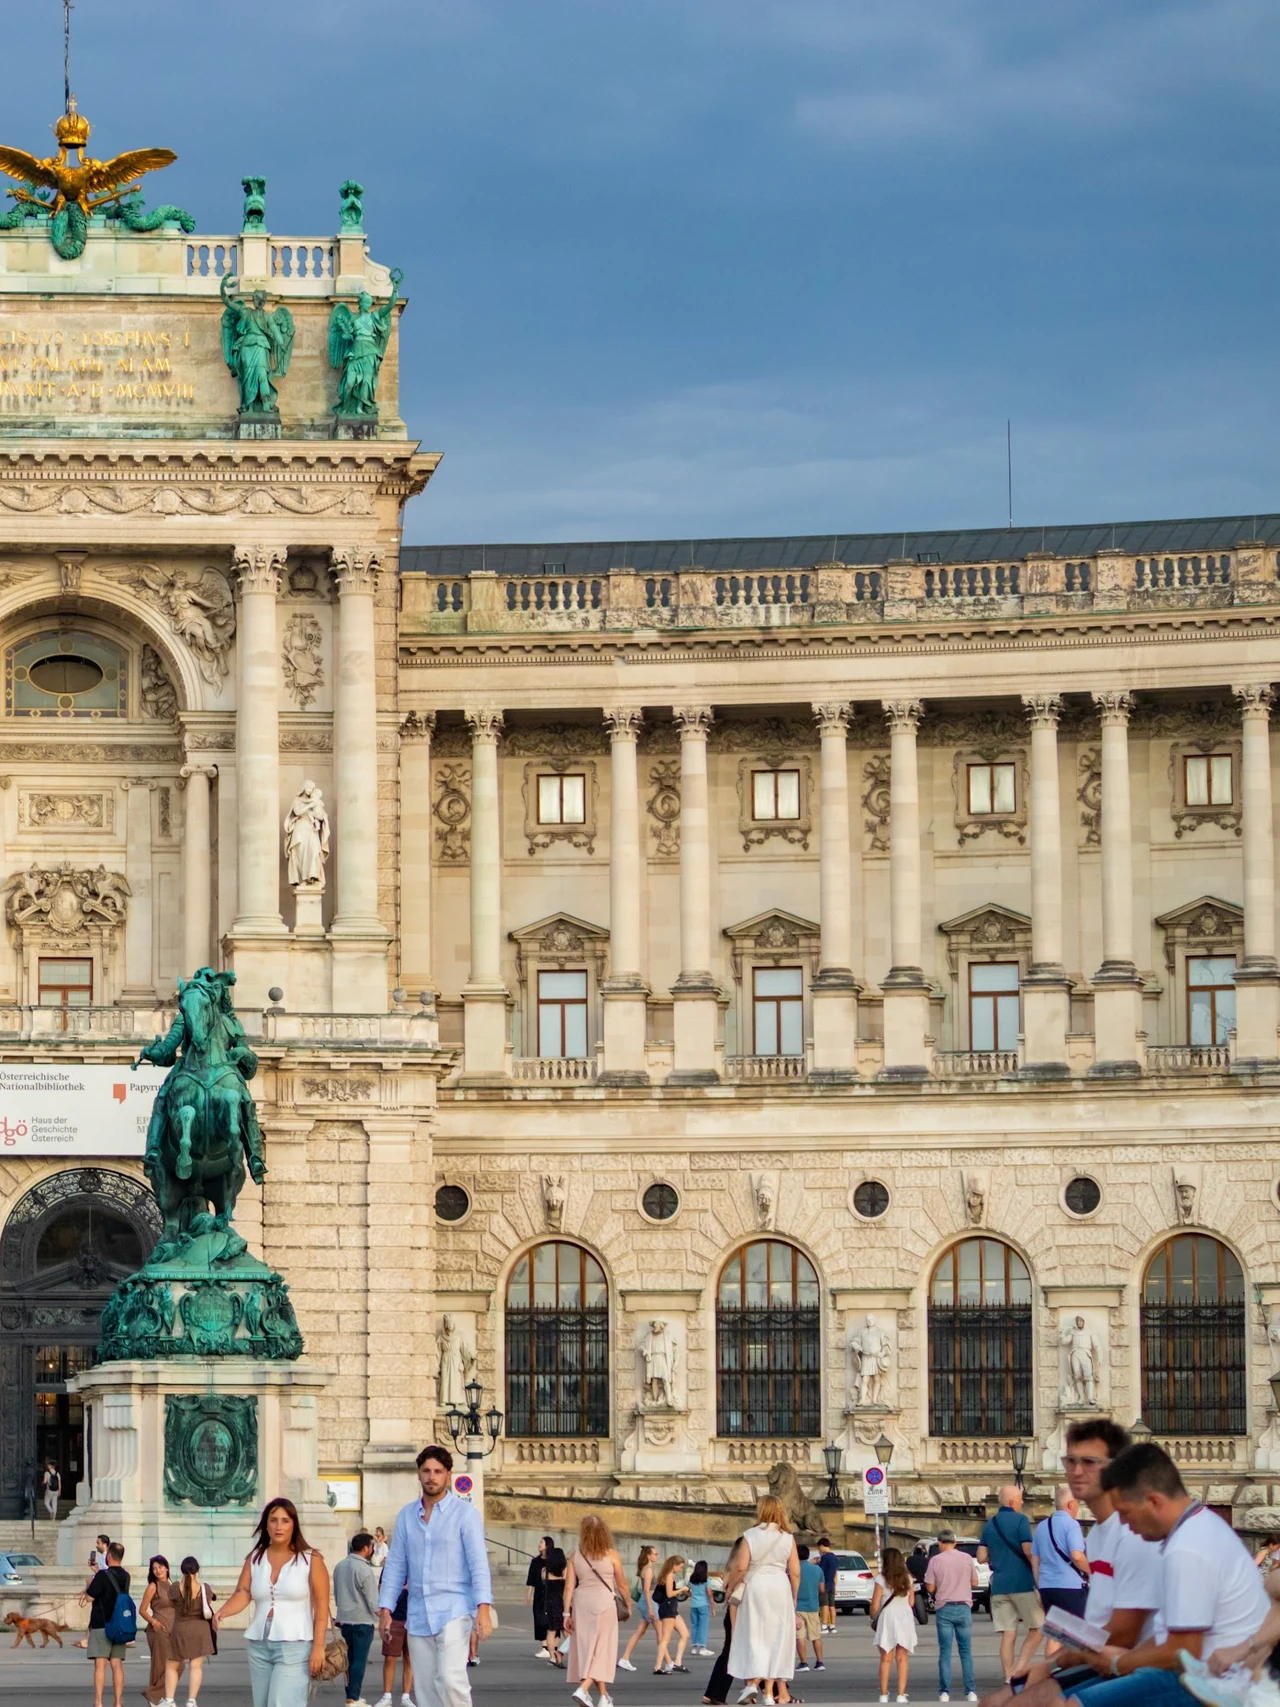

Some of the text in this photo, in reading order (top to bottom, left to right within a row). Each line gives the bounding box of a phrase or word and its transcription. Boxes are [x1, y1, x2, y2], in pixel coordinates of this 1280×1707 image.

[83, 330, 171, 346] IOSEPHVS
[184, 331, 190, 347] I
[115, 357, 171, 373] ALAM
[66, 382, 80, 398] A
[91, 383, 104, 399] D
[115, 383, 194, 399] MCMVIII
[31, 1116, 68, 1124] Haus der
[31, 1125, 78, 1134] Geschichte
[31, 1133, 74, 1142] Österreich
